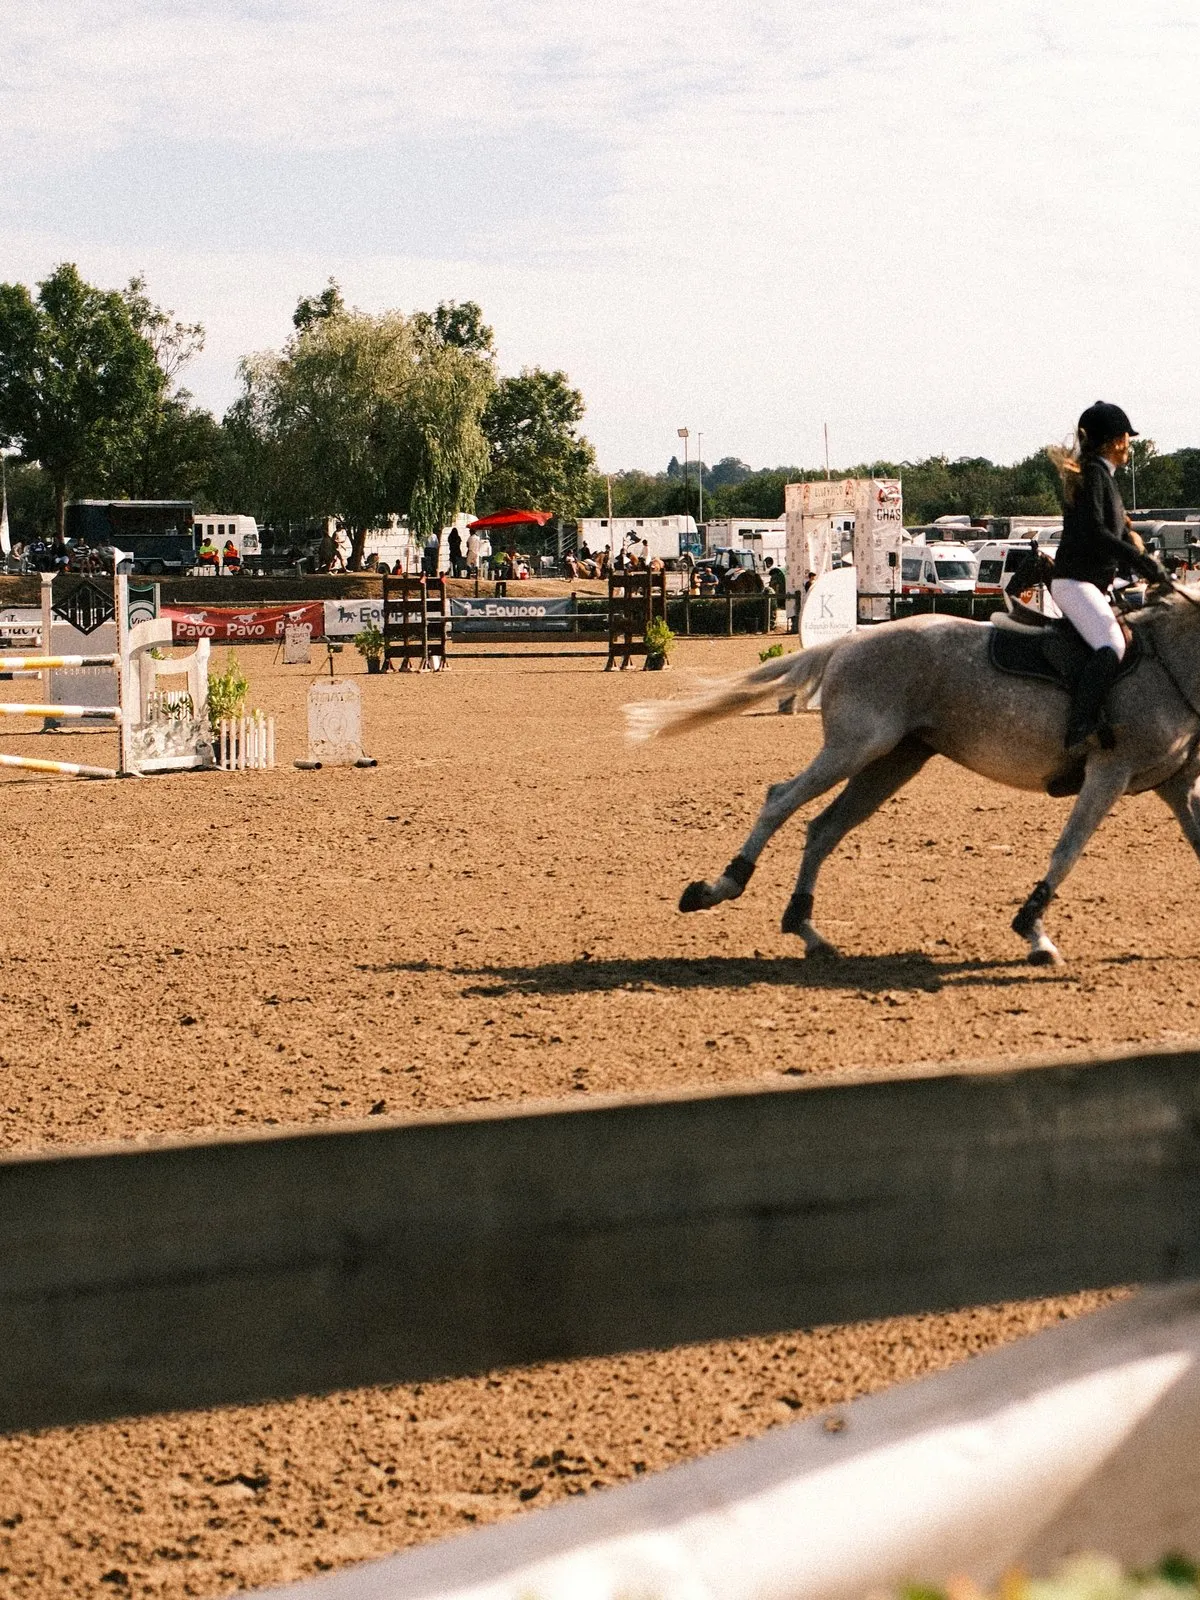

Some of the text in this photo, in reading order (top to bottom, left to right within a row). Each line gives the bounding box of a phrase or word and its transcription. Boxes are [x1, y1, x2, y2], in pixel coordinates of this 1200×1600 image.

[877, 509, 900, 521] CHAS
[820, 594, 834, 618] K
[176, 623, 216, 636] Pavo
[226, 623, 265, 636] Pavo
